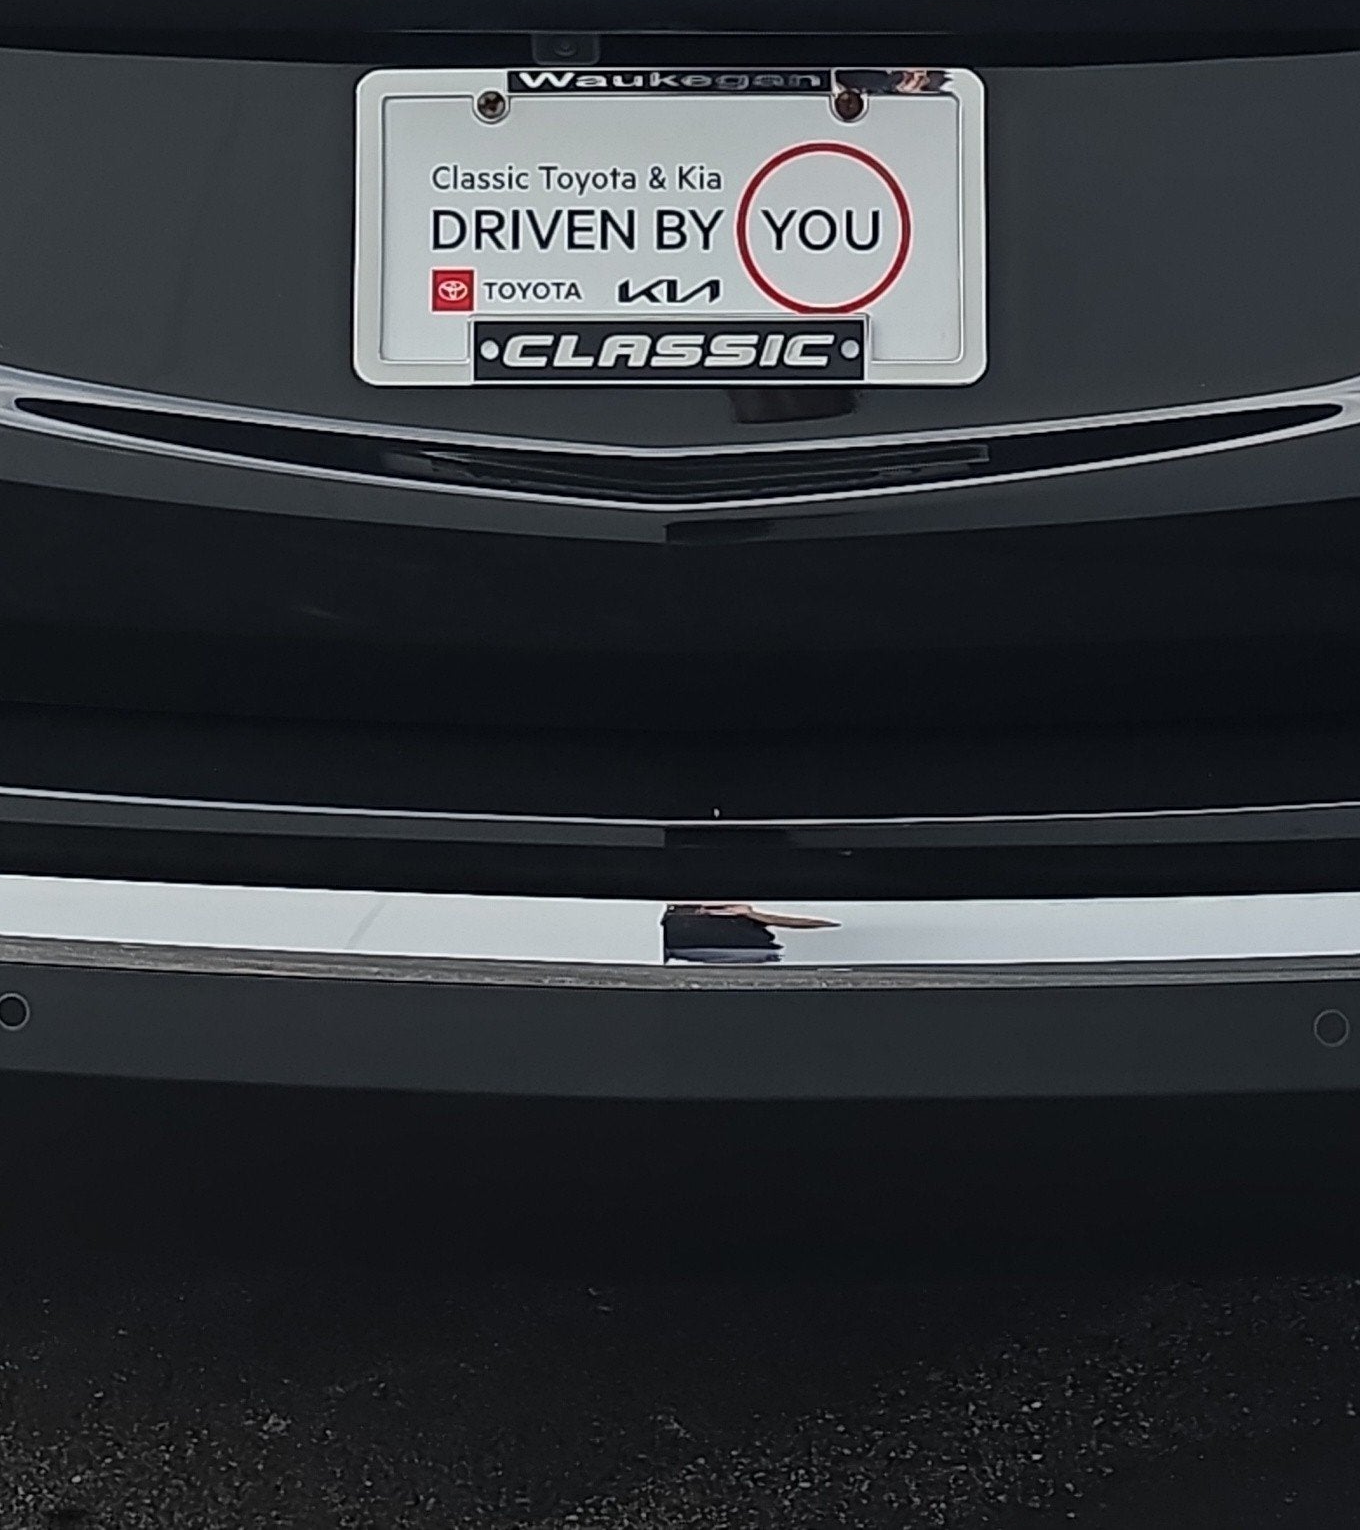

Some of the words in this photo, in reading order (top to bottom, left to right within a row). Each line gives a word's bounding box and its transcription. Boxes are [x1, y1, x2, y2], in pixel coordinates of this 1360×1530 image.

[517, 71, 821, 88] Waukegan
[432, 166, 529, 190] Classic
[539, 166, 636, 196] Toyota
[649, 167, 667, 190] &
[679, 166, 722, 190] Kia
[432, 209, 635, 251] DRIVEN
[655, 209, 723, 251] BY
[761, 209, 880, 251] YOU
[483, 281, 581, 301] TOYOTA
[617, 279, 721, 304] KIA
[500, 334, 834, 366] CLASSIC
